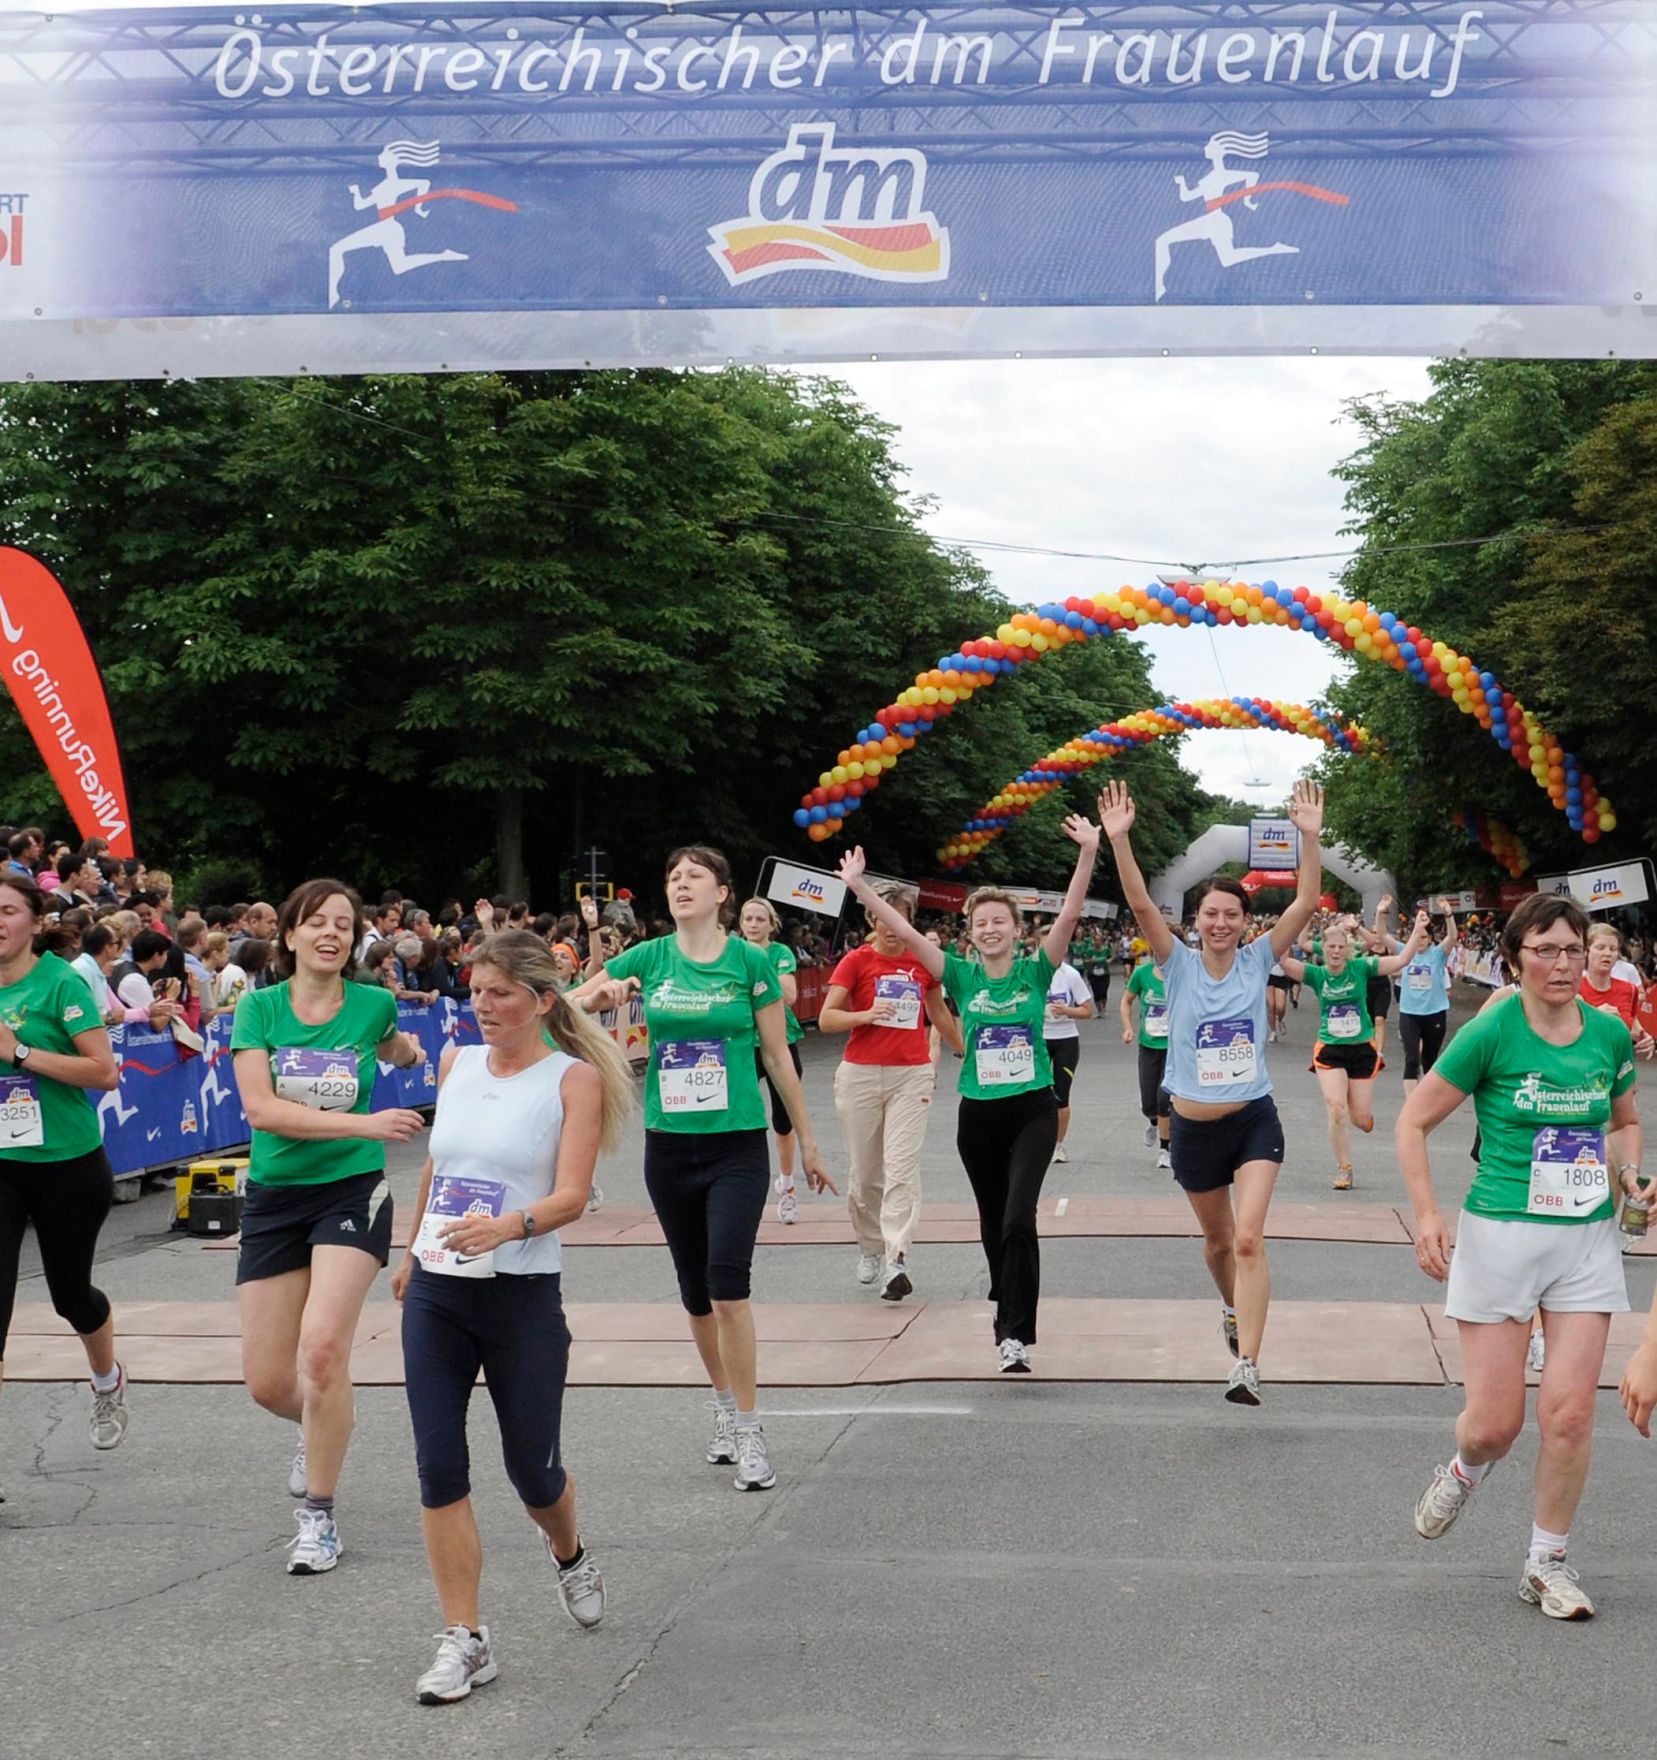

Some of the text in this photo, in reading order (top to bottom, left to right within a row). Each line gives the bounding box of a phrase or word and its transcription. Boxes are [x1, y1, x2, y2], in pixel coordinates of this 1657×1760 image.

[215, 10, 1483, 98] Österreichischer dm Frauenlauf
[759, 131, 915, 222] dm
[1263, 827, 1285, 840] dm
[798, 878, 823, 895] dm
[1593, 878, 1617, 894] dm
[998, 1048, 1032, 1063] 4049
[1219, 1046, 1254, 1062] 8558
[328, 1063, 347, 1074] dm
[684, 1070, 725, 1086] 4827
[12, 1087, 29, 1099] dm
[308, 1081, 356, 1097] 4229
[0, 1106, 37, 1121] 3251
[1536, 1100, 1591, 1113] Frauenlauf
[1564, 1168, 1606, 1186] 1808
[470, 1201, 490, 1214] dm
